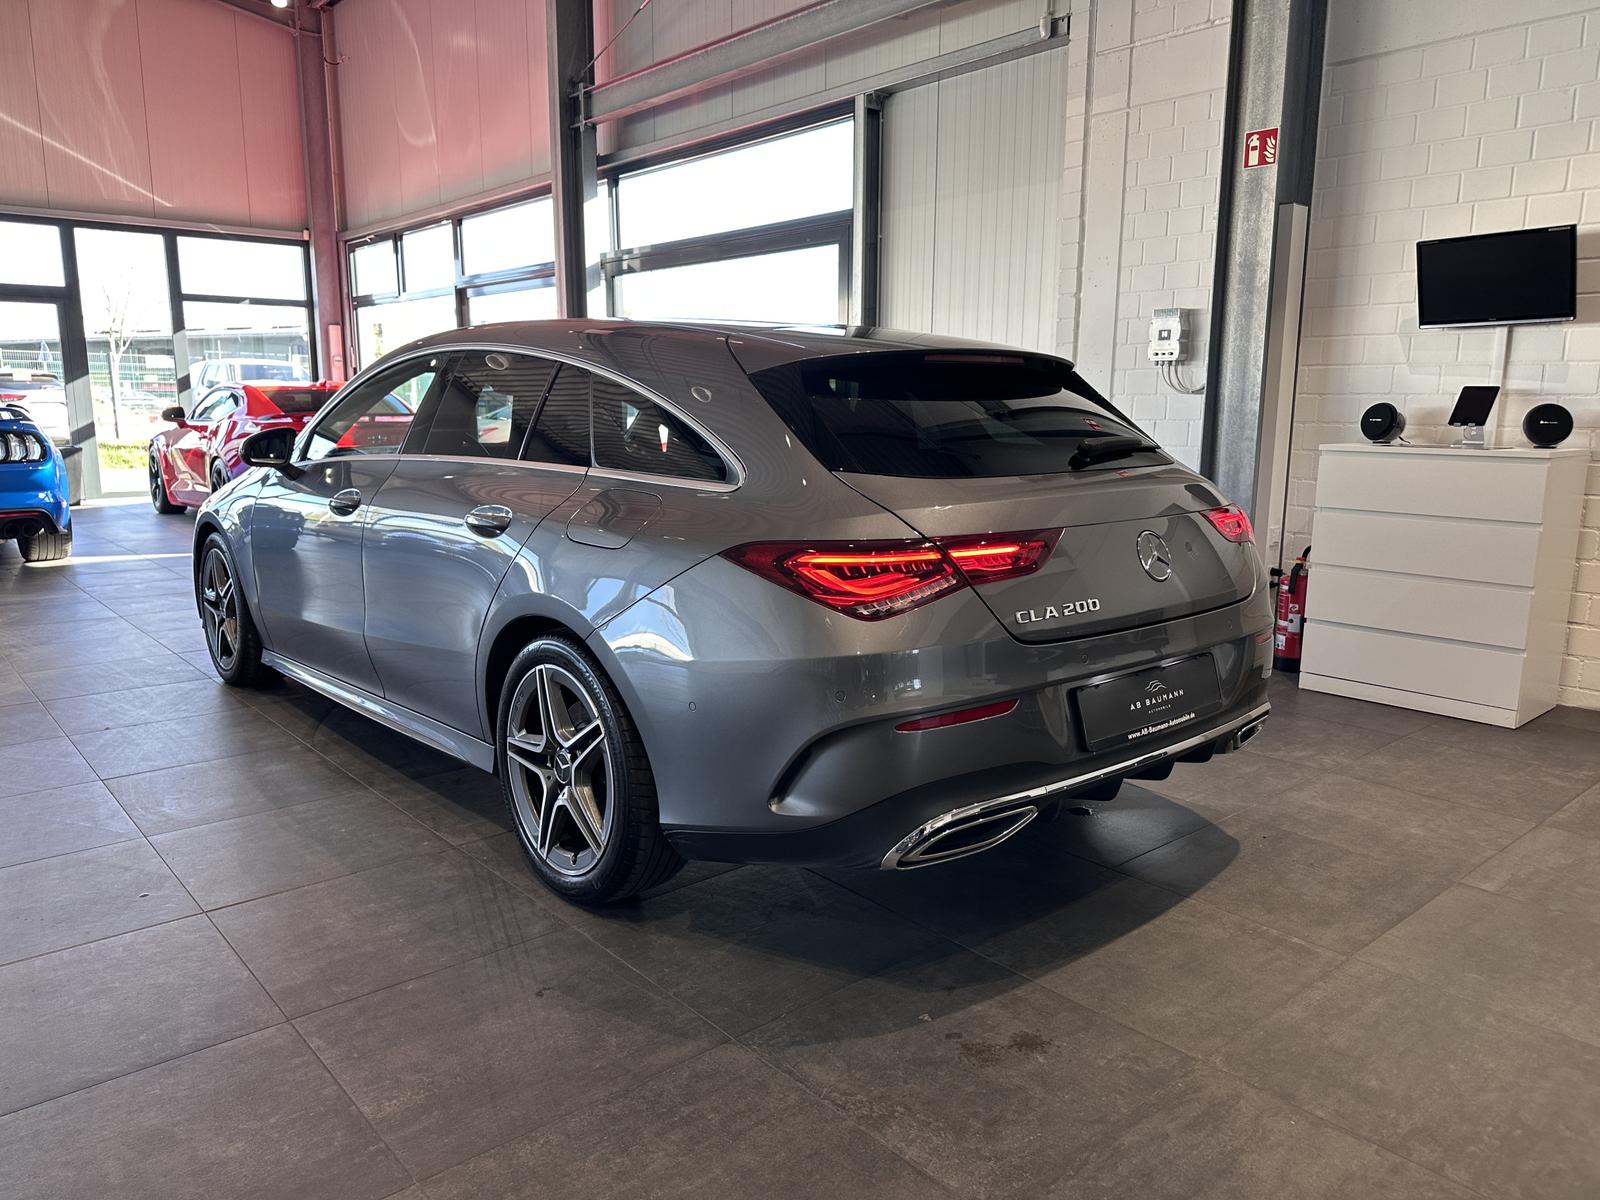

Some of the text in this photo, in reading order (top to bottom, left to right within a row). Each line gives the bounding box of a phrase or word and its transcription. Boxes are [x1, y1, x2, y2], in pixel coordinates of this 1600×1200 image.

[1015, 598, 1101, 624] CLA 200
[1130, 689, 1184, 711] AB BAUMANN
[1127, 711, 1196, 740] www.AB-Baumann-Automobile.de
